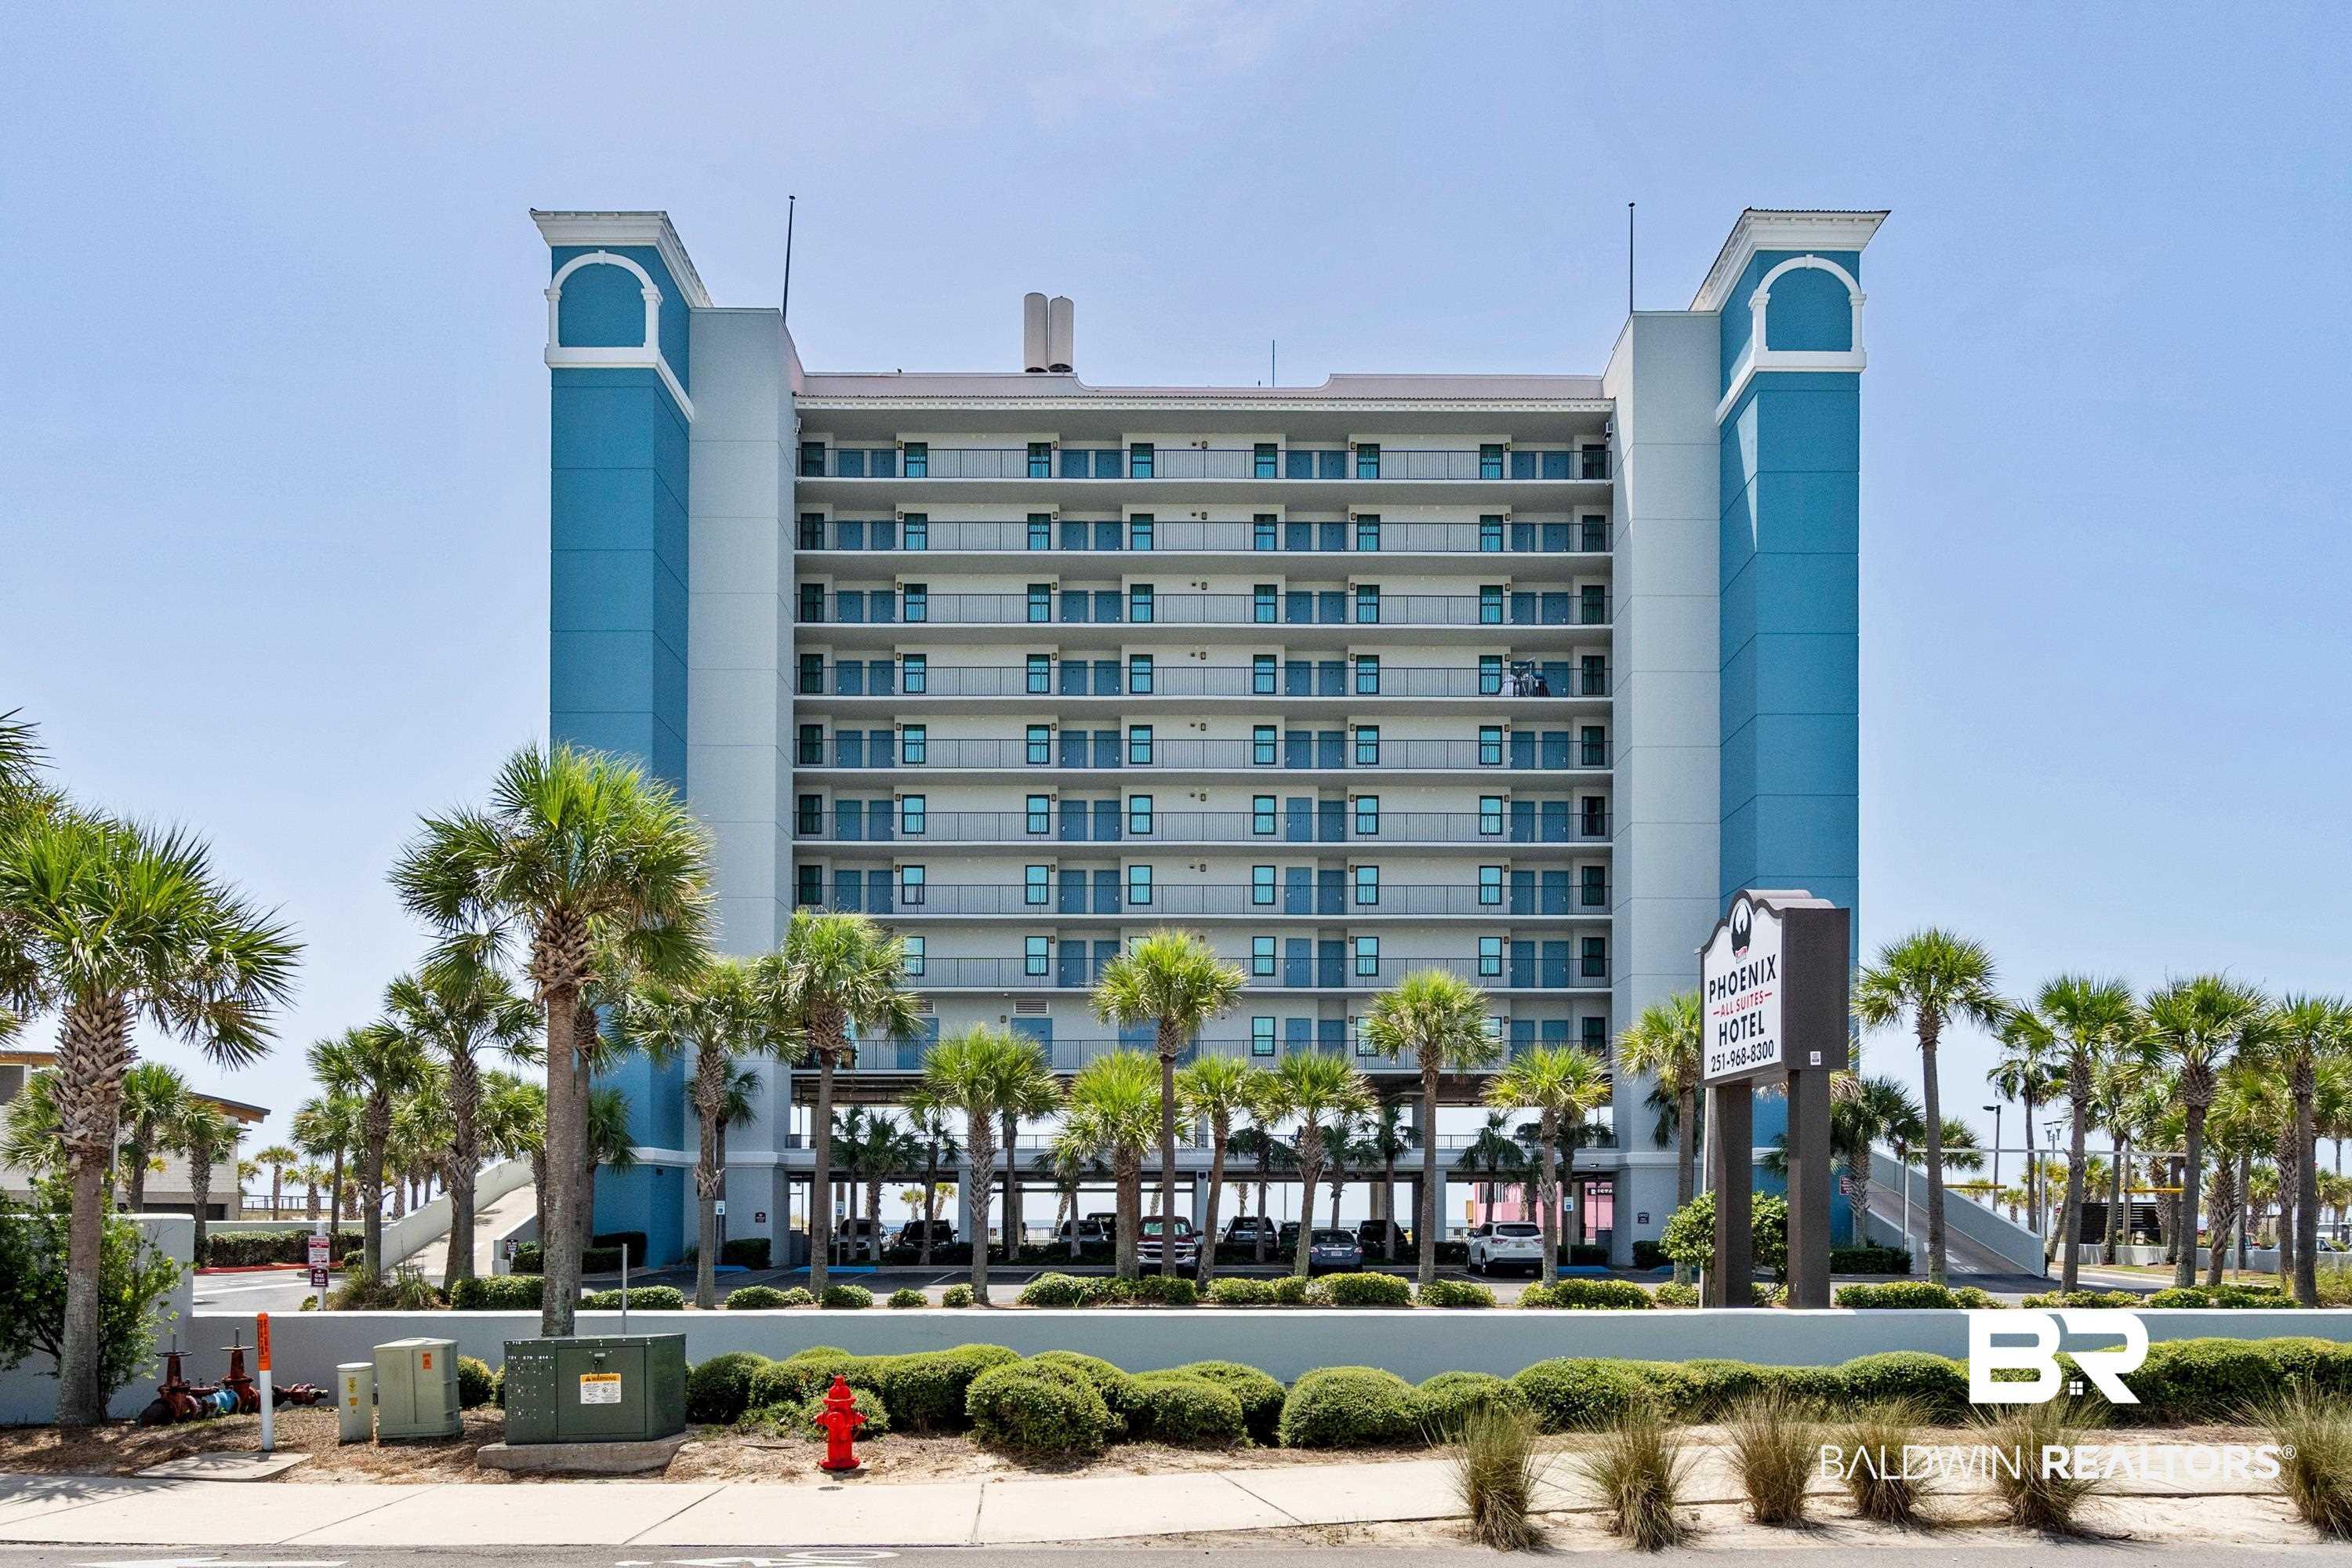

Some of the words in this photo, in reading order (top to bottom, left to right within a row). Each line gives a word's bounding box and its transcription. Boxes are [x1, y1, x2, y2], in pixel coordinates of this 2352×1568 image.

[1709, 953, 1777, 1004] PHOENIX
[1720, 1001, 1733, 1018] ALL
[1736, 989, 1764, 1012] SUITES
[1719, 1010, 1765, 1047] HOTEL
[1711, 1039, 1774, 1073] 251-968-8300
